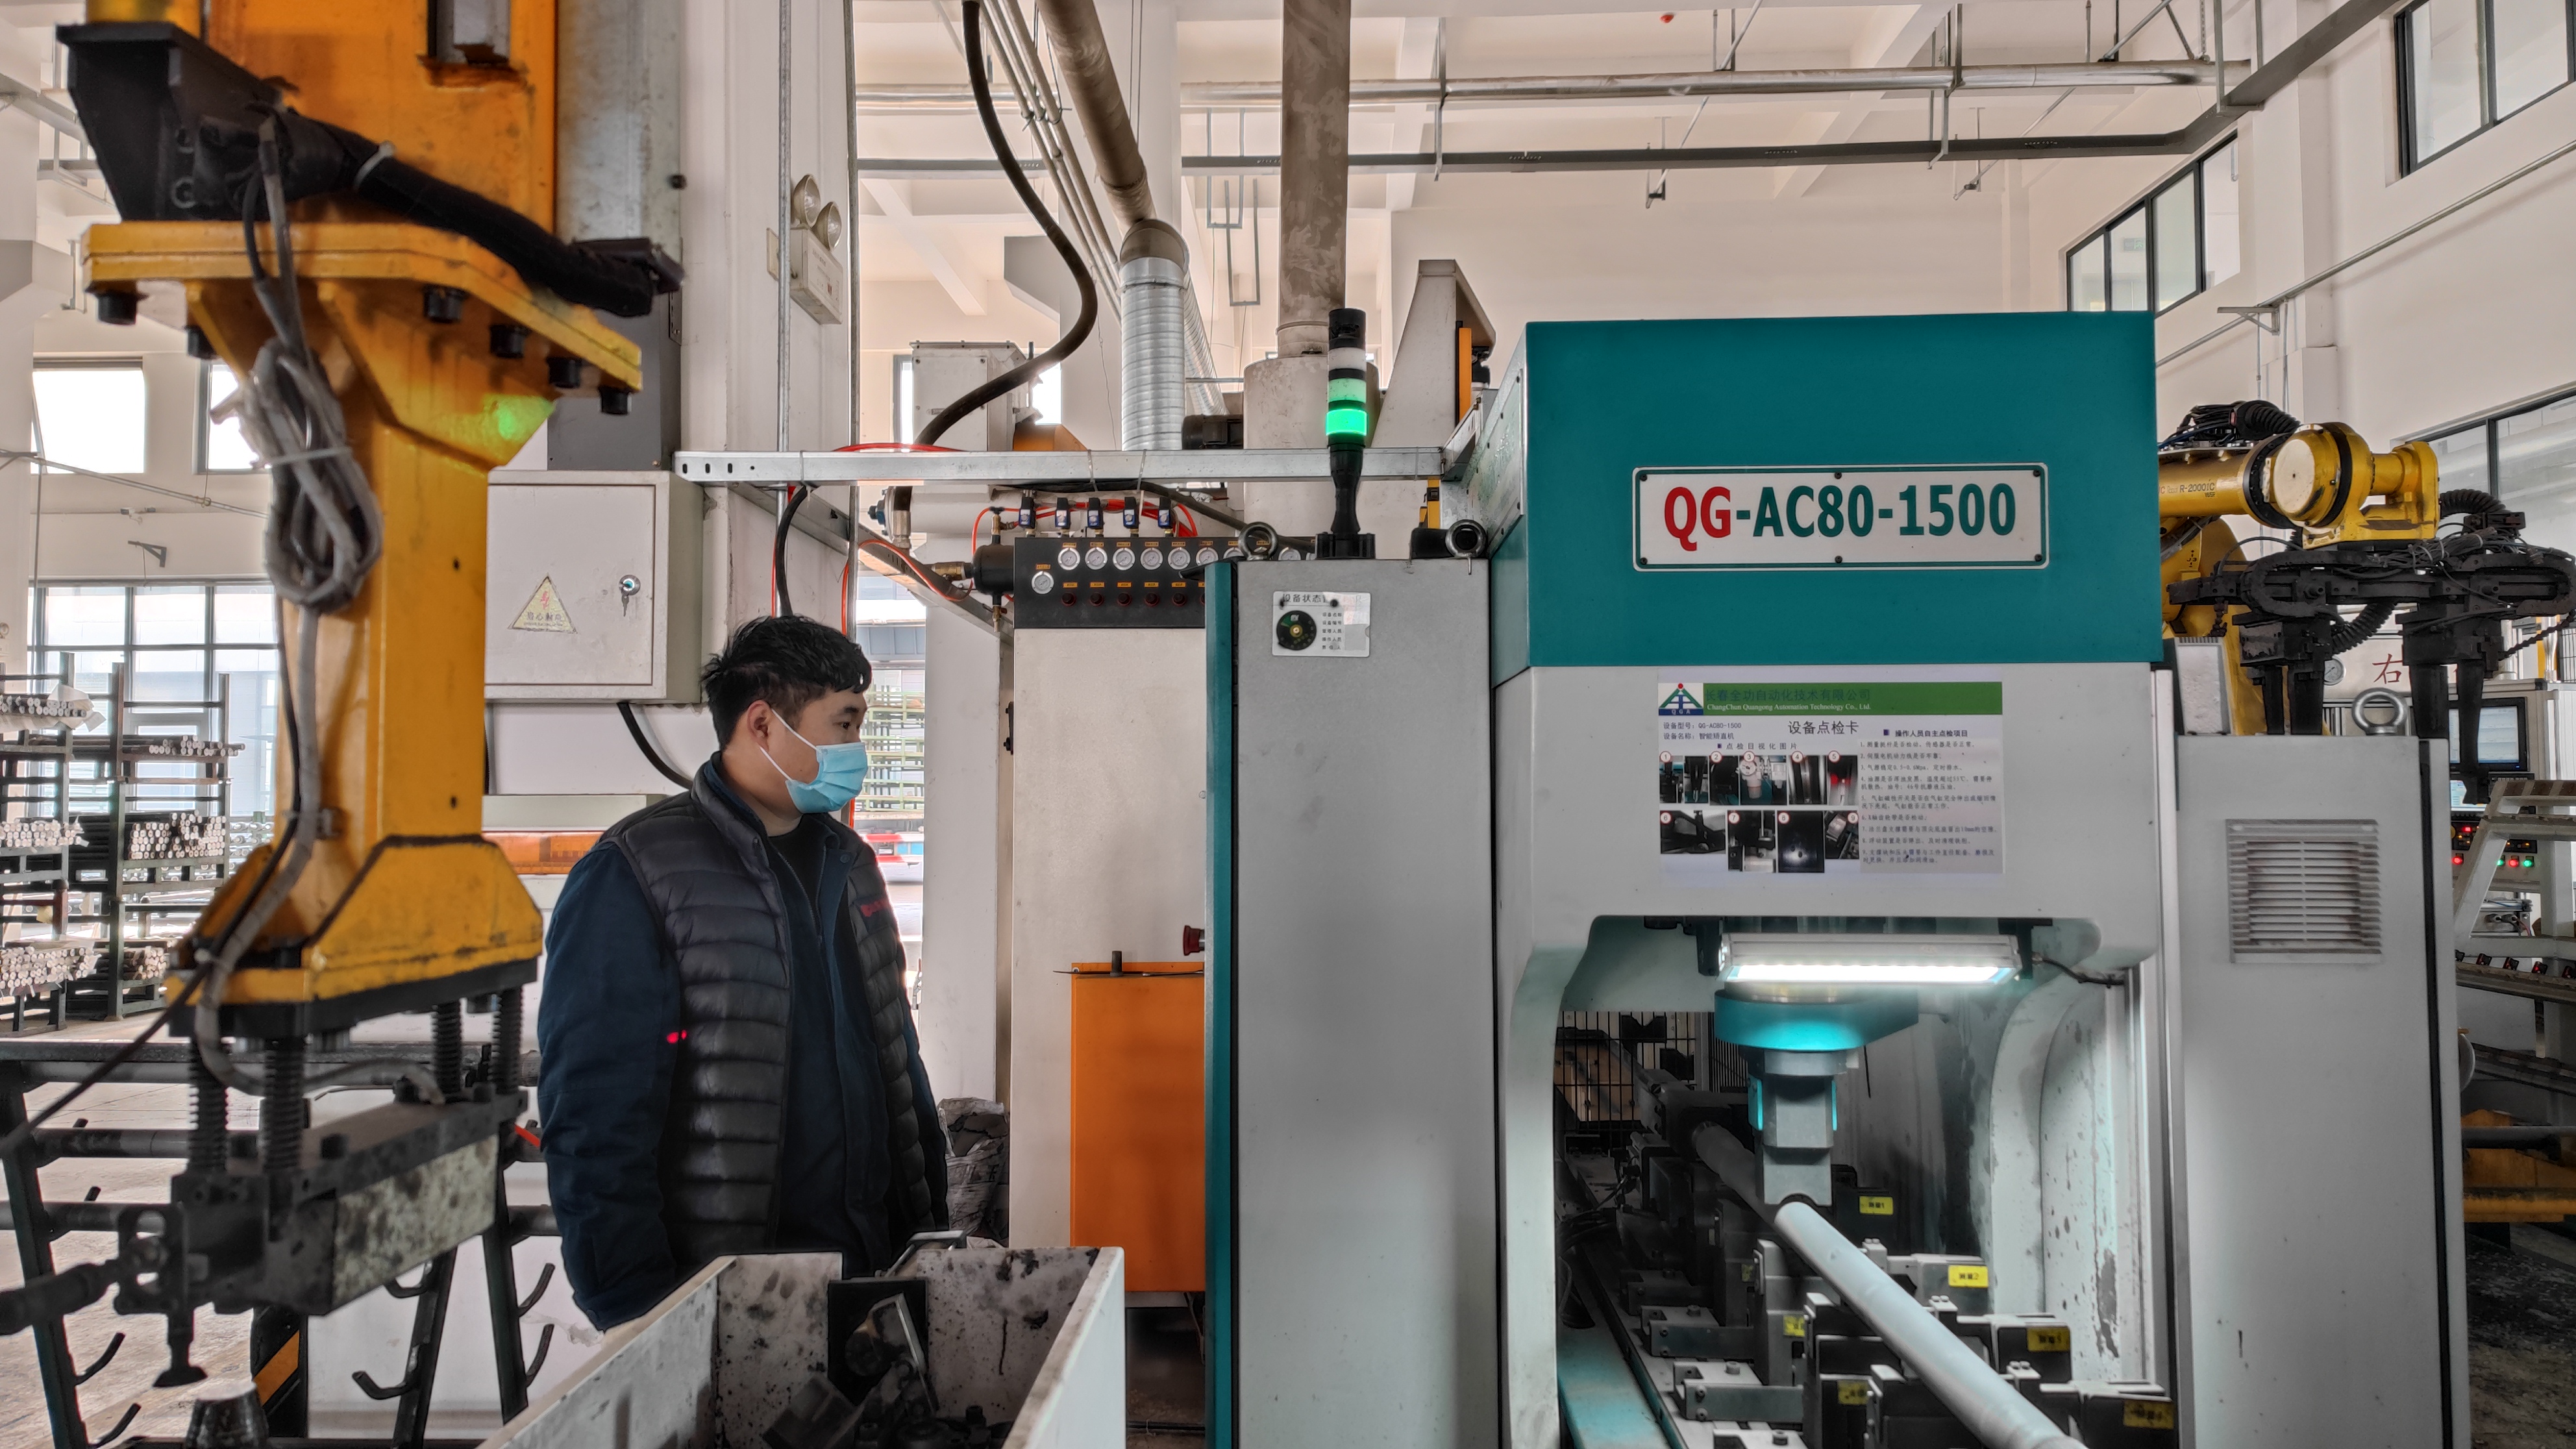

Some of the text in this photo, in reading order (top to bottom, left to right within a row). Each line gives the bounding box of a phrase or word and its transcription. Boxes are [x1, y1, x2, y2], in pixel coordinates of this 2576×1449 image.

[1664, 483, 2016, 551] QG-AC80-1500
[1283, 594, 1330, 602] 设备状态
[2372, 653, 2403, 684] 右
[1810, 703, 1843, 712] Technology
[1788, 720, 1859, 735] 设备点检卡
